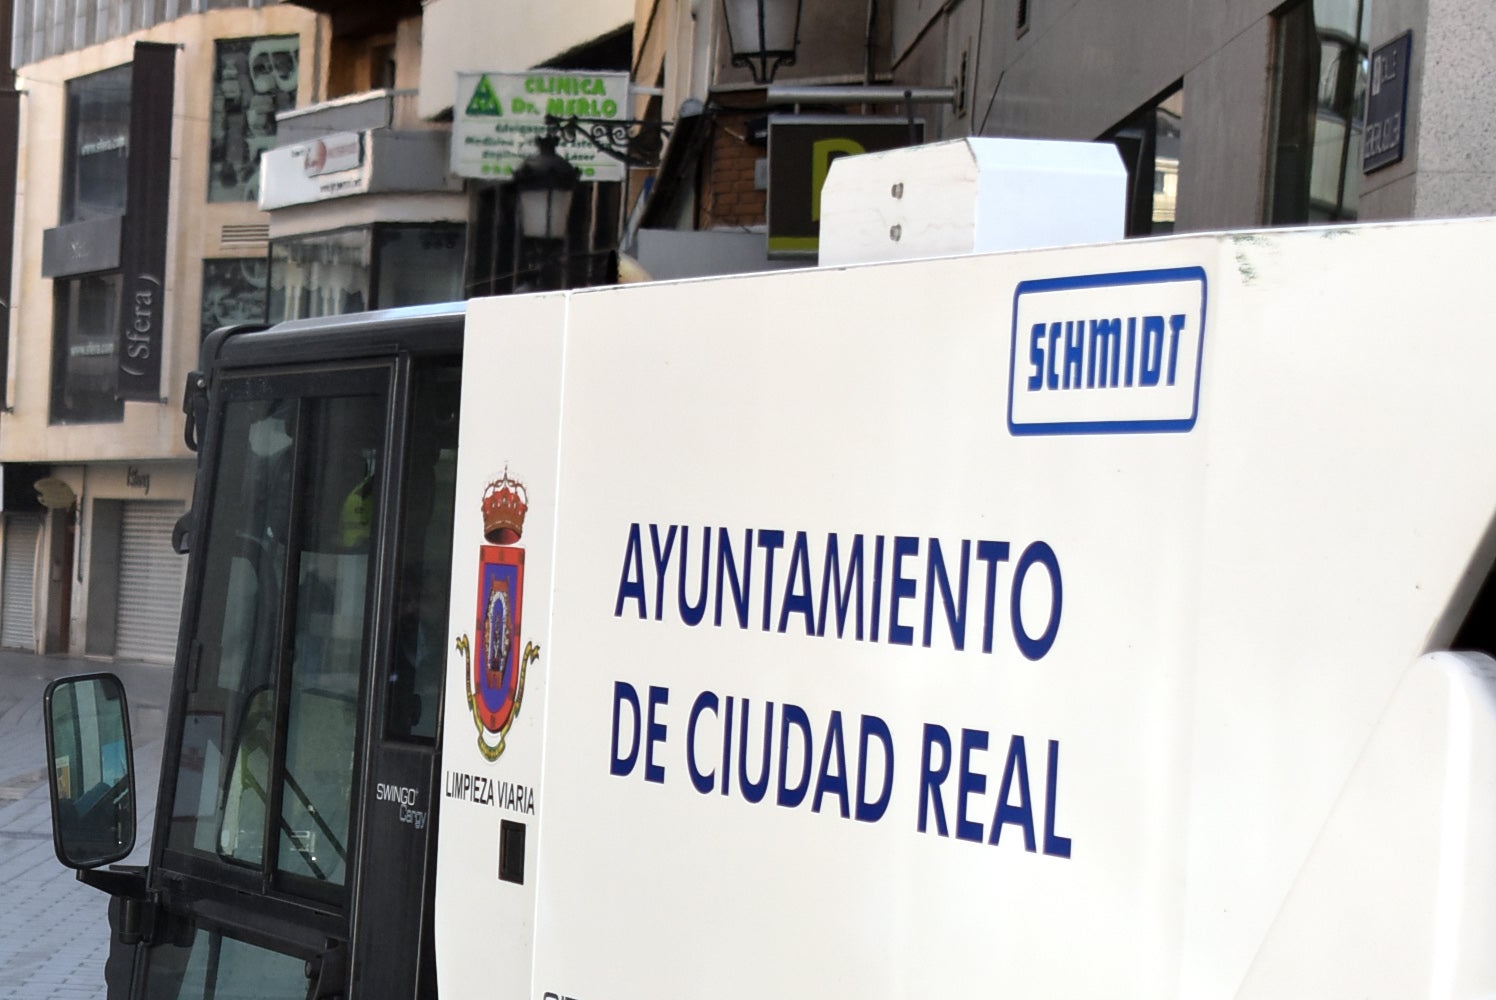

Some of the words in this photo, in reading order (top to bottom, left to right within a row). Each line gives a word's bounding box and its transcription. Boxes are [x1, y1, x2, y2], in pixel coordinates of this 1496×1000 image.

[511, 97, 540, 115] Dr.
[547, 98, 618, 118] MERLO
[1027, 314, 1186, 391] SCHMIDT
[614, 522, 1063, 662] AYUNTAMIENTO
[445, 771, 494, 807] LIMPIEZA
[497, 781, 535, 816] VIARIA
[609, 680, 670, 785] DE
[686, 690, 895, 824] CIUDAD
[916, 722, 1073, 860] REAL
[399, 803, 427, 829] Cargy
